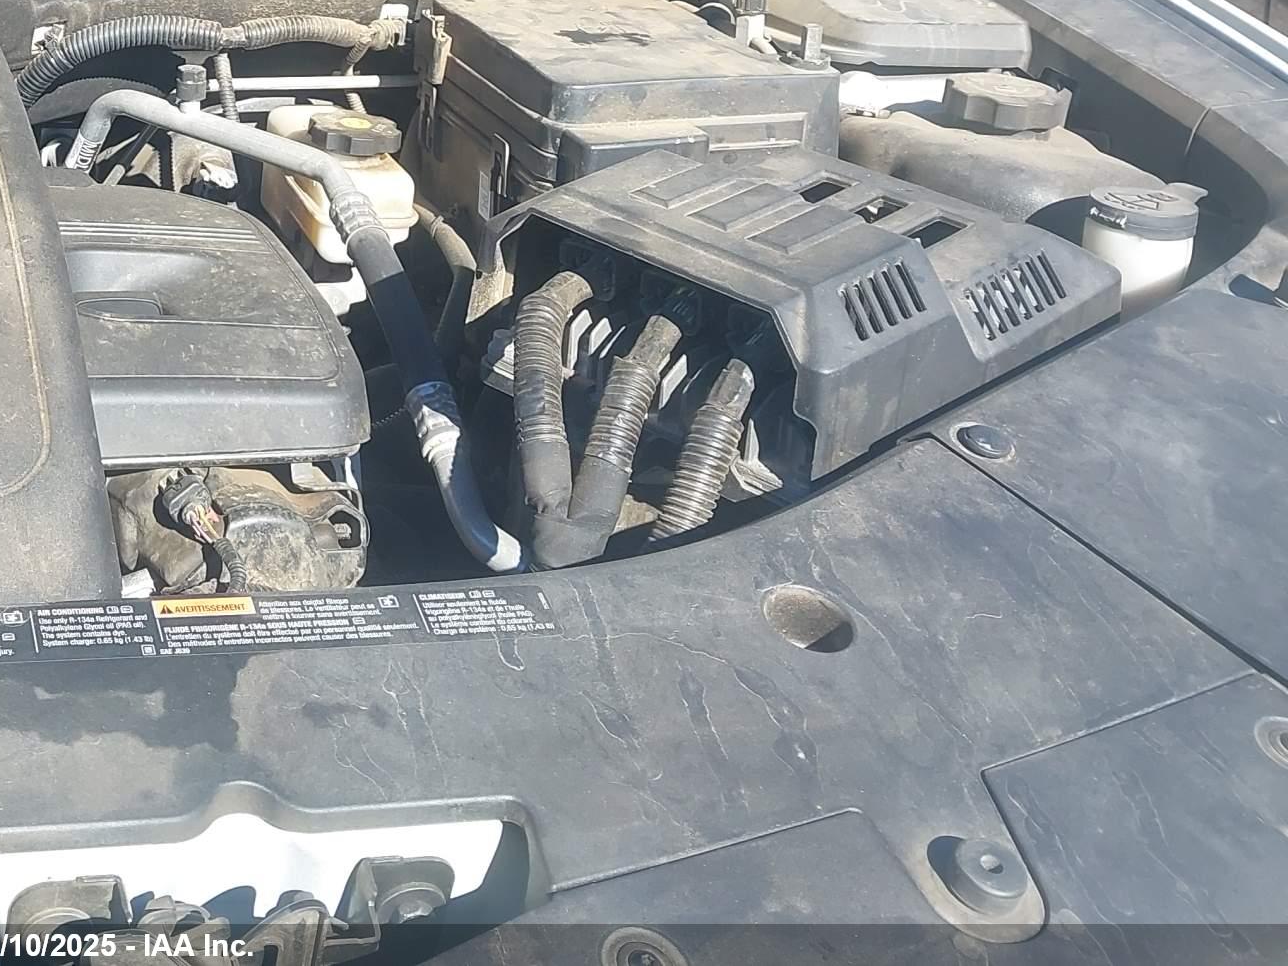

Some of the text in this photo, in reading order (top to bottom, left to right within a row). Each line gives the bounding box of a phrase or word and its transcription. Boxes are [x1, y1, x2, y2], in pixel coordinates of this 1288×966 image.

[52, 607, 104, 616] CONDITIONING
[175, 604, 245, 613] AVERTISSEMENT
[96, 615, 134, 623] Refrigerant
[40, 624, 82, 632] Polyalkylene
[70, 638, 96, 646] charge:
